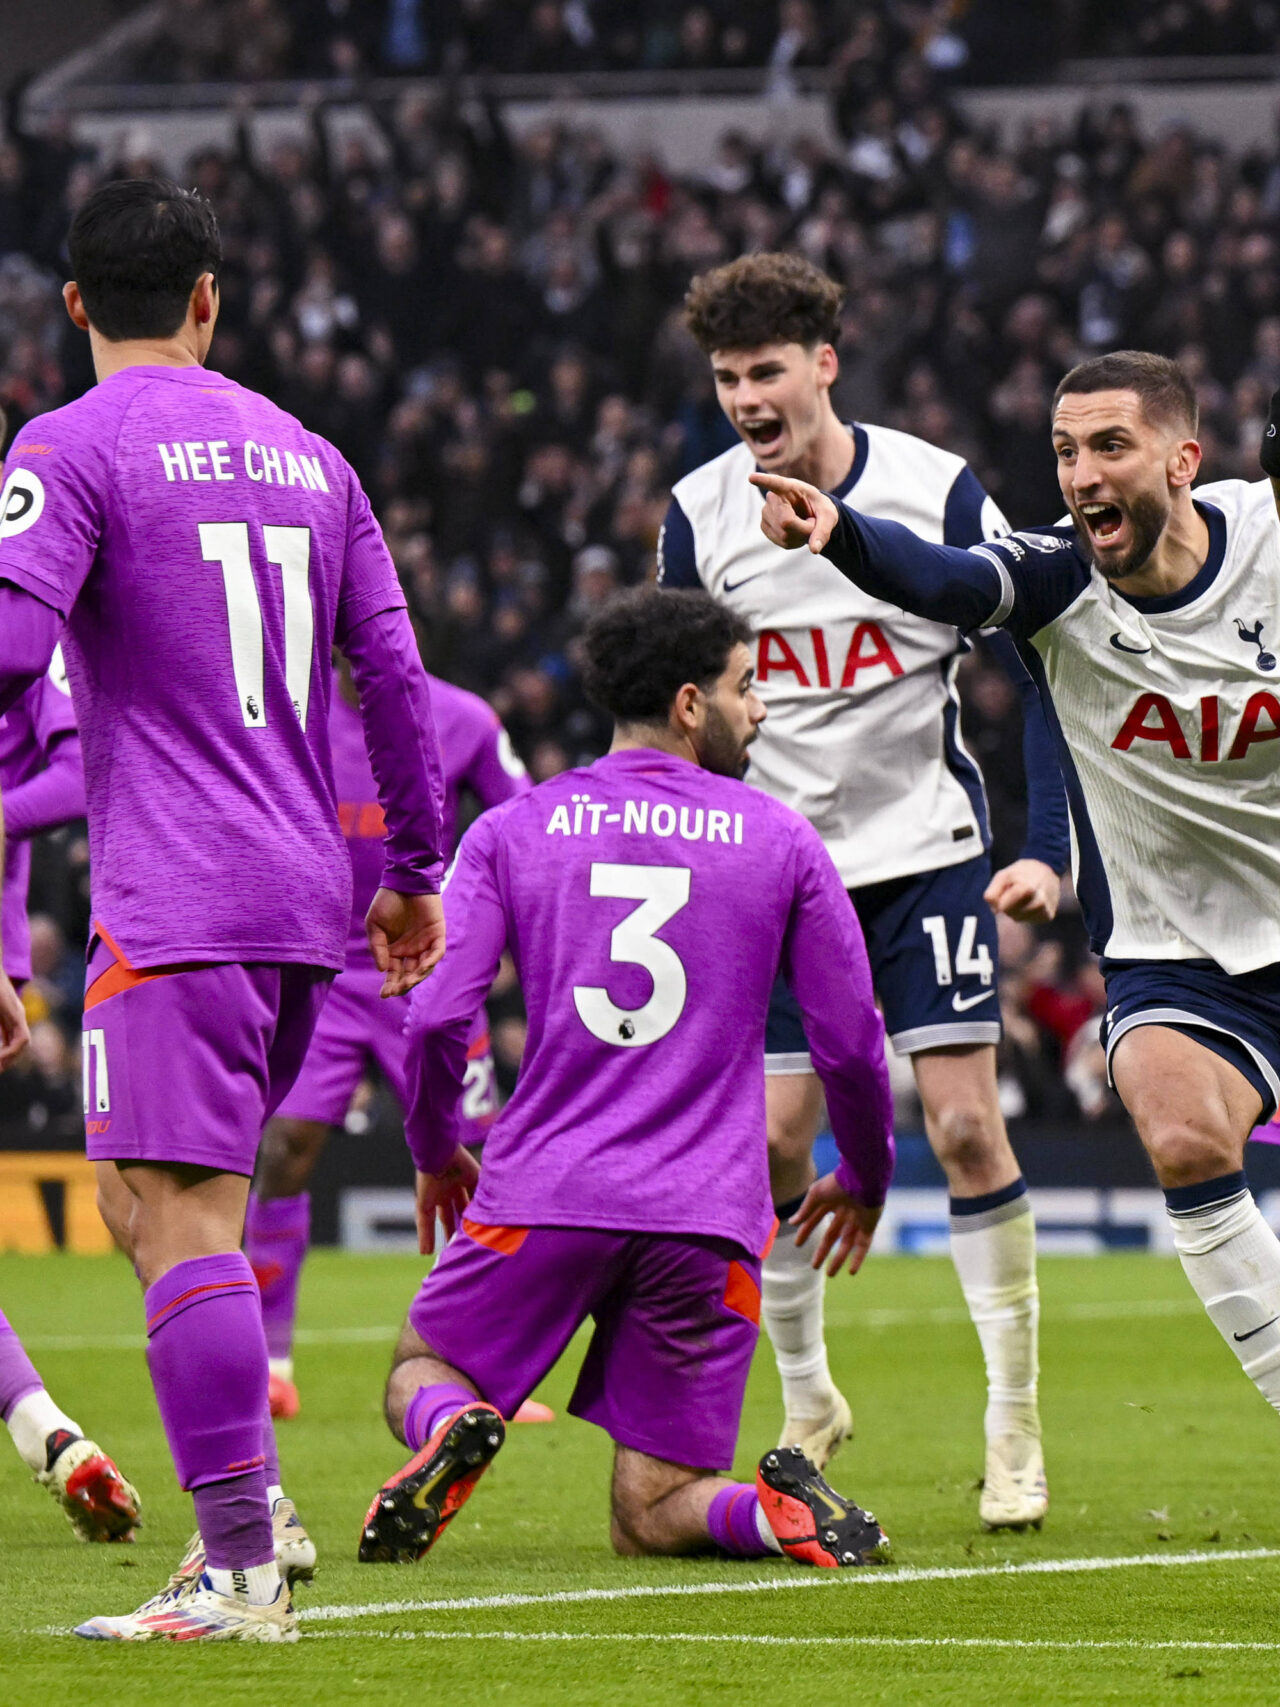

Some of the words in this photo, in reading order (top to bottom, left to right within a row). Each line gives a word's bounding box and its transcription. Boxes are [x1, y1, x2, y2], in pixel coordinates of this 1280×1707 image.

[158, 440, 235, 482] HEE
[243, 440, 330, 493] CHAN
[197, 522, 314, 734] 11
[756, 621, 905, 688] AIA
[546, 794, 743, 844] AÏT-NOURI
[573, 862, 691, 1047] 3
[922, 915, 994, 986] 14
